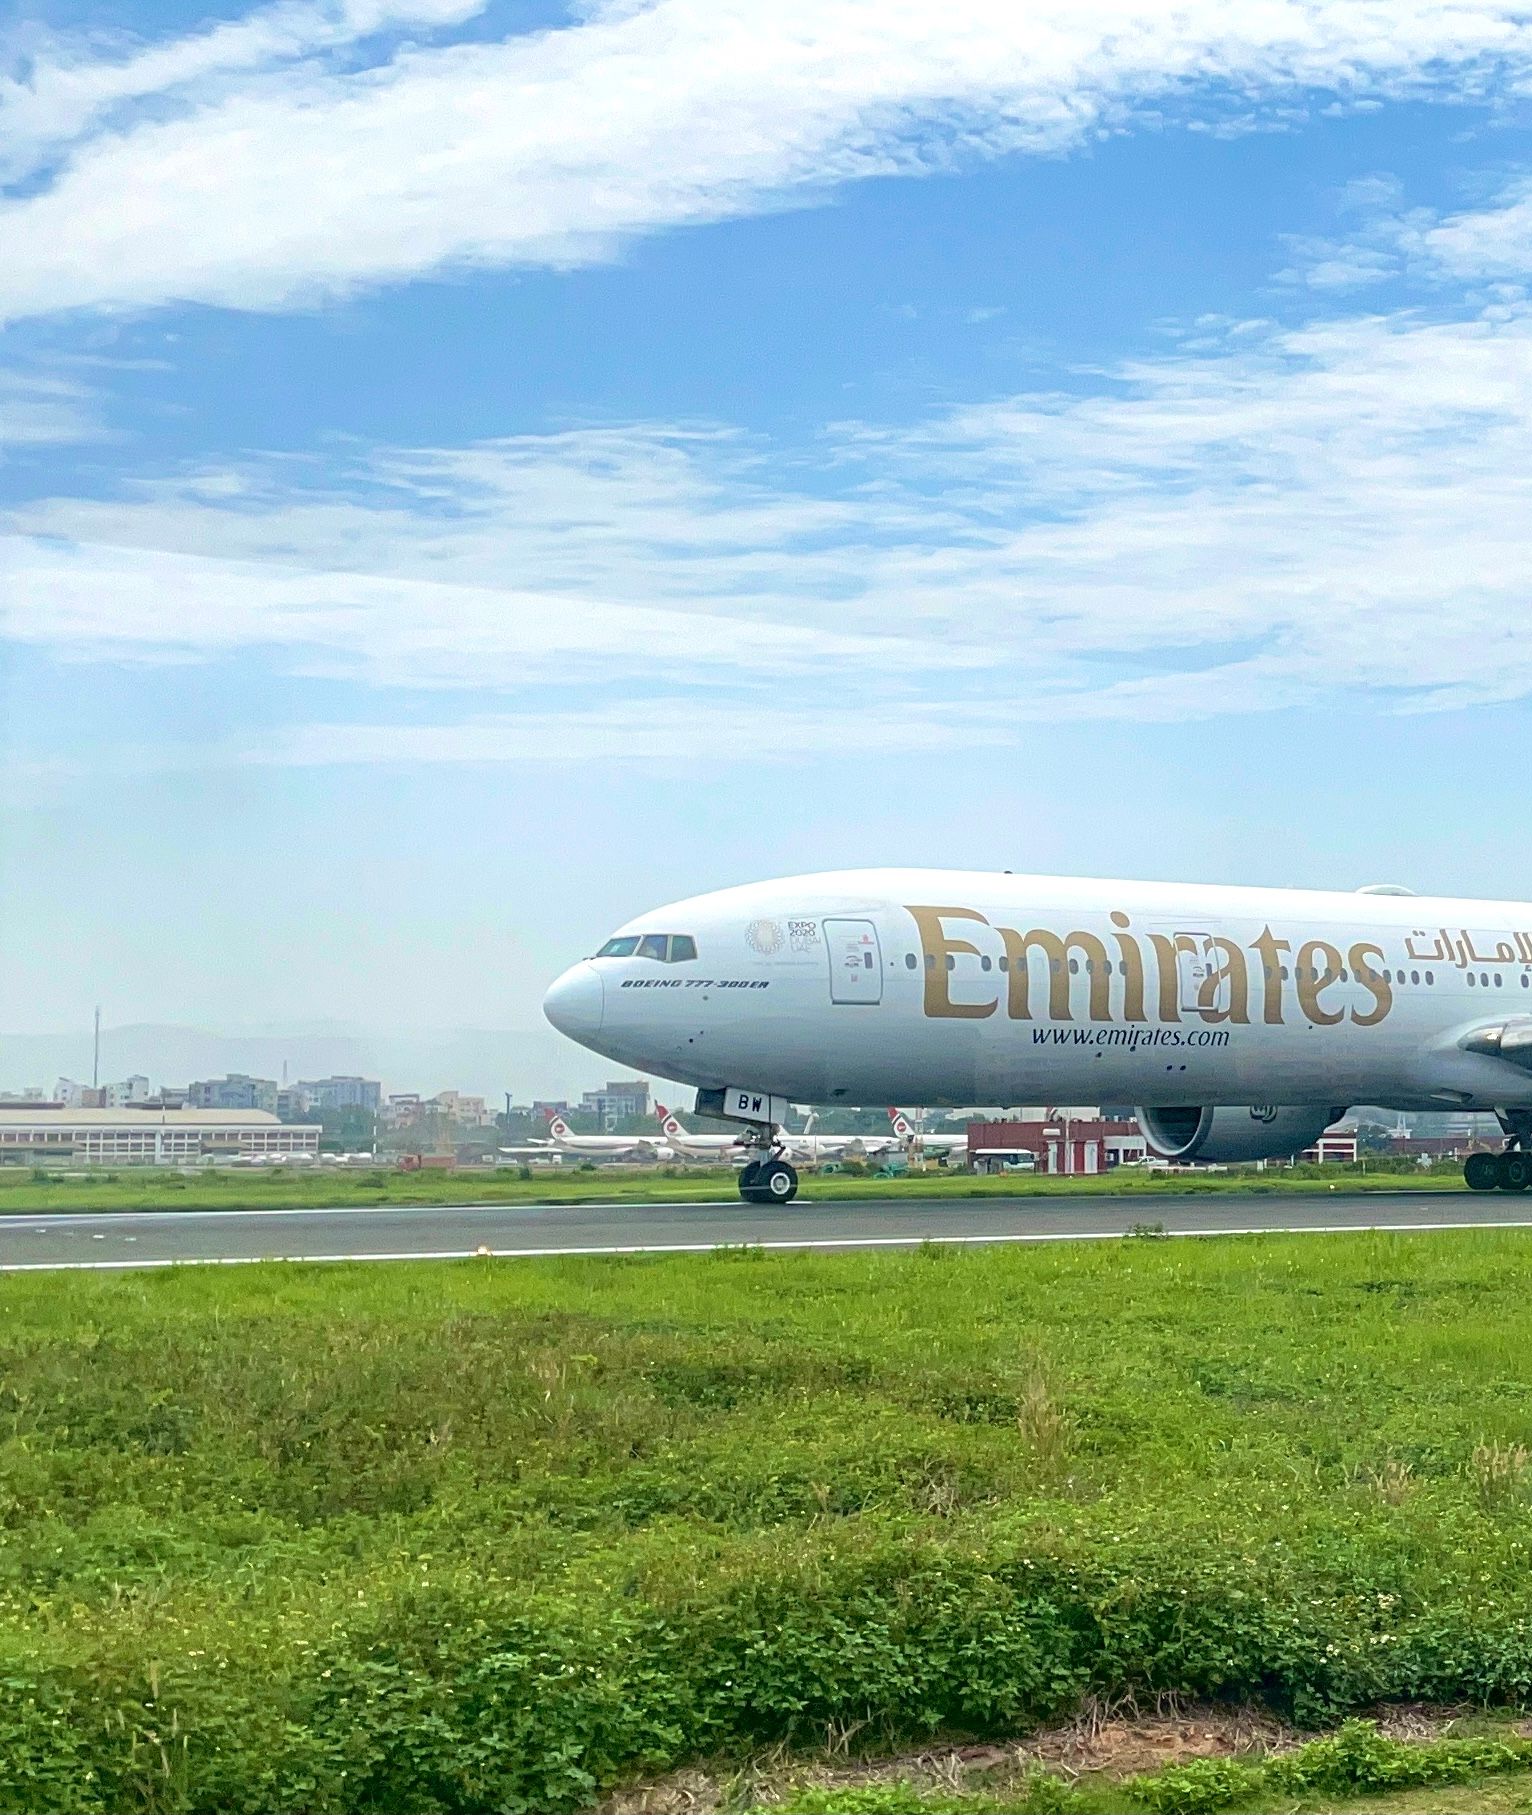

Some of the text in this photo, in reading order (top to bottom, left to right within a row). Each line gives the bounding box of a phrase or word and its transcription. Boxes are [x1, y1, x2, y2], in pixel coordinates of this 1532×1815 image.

[788, 921, 816, 930] EXPO
[789, 929, 816, 937] 2020
[903, 905, 1393, 1026] Emirates
[621, 979, 770, 989] BOEING 777-300ER
[1032, 1024, 1230, 1047] www.emirates.com
[738, 1094, 762, 1113] BW
